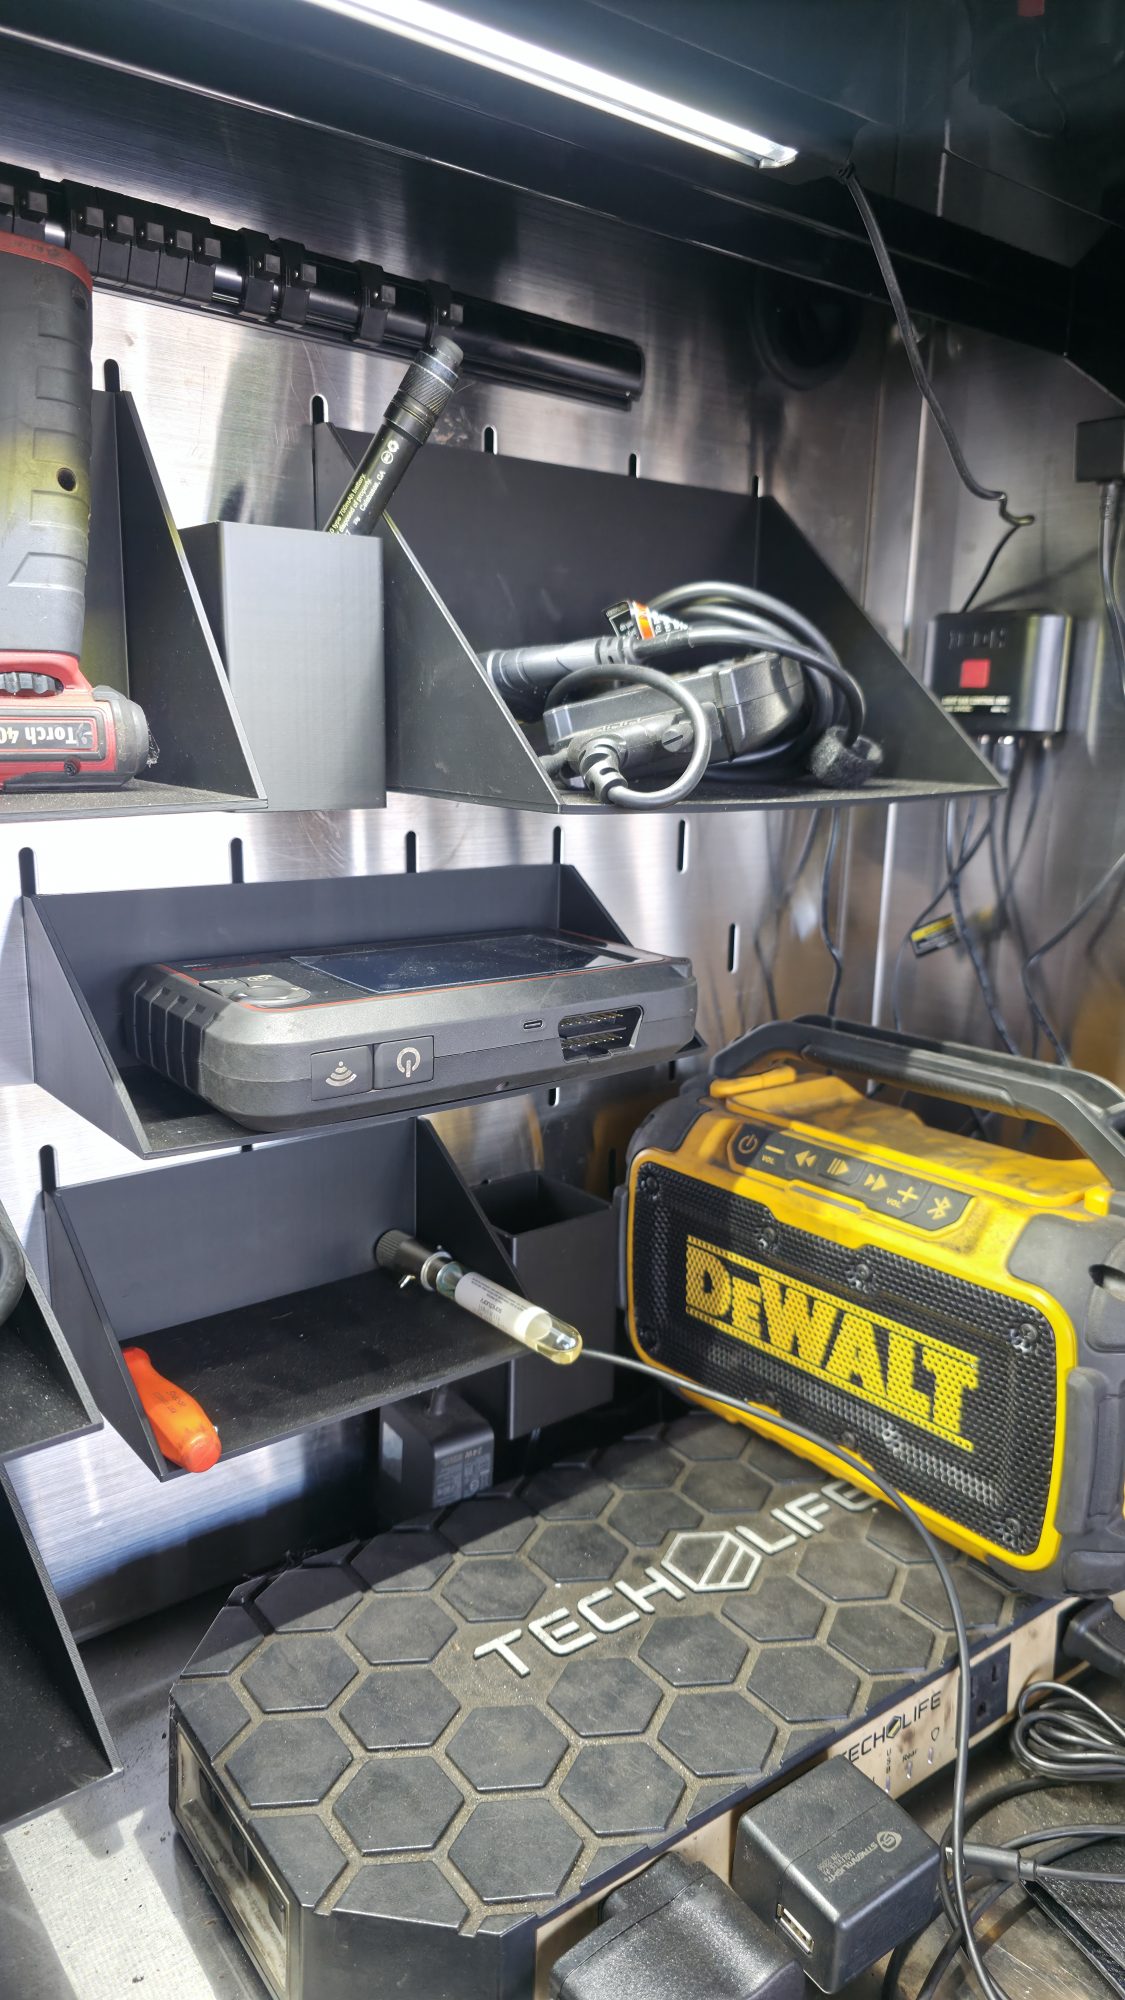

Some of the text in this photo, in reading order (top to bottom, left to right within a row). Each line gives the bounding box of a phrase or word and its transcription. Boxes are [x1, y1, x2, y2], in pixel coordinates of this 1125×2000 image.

[25, 727, 77, 745] Torch
[761, 1154, 775, 1166] VOL
[886, 1196, 902, 1210] VOL
